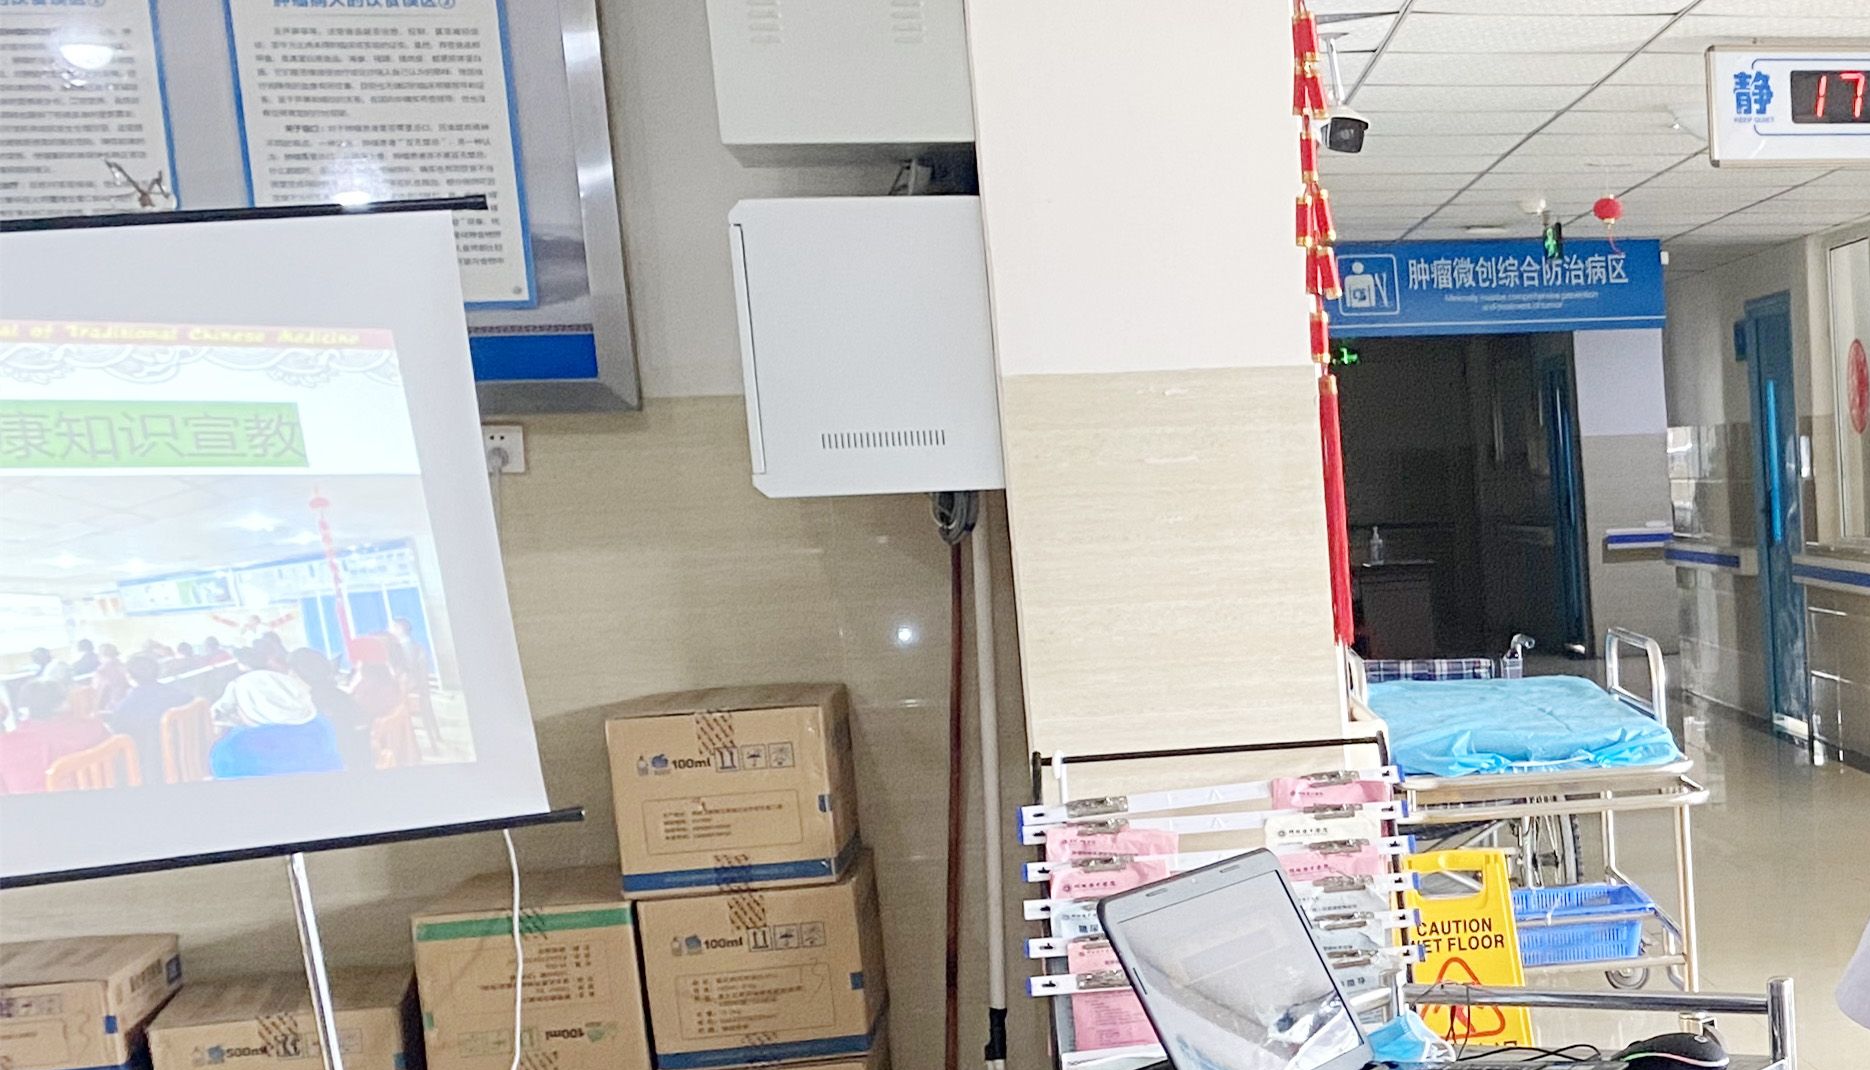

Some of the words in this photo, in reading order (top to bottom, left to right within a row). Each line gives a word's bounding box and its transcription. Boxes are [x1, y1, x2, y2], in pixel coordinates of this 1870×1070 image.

[1733, 71, 1773, 115] 静
[1408, 252, 1629, 291] 肿瘤微创综合防治病区
[66, 324, 178, 341] Traditional
[188, 327, 265, 343] Chinese
[278, 329, 361, 345] Medicine
[0, 411, 307, 460] 康知识宣教
[671, 756, 711, 770] 100ml
[1417, 918, 1492, 936] CAUTION
[704, 936, 743, 950] 100ml
[1447, 934, 1505, 952] FLOOR
